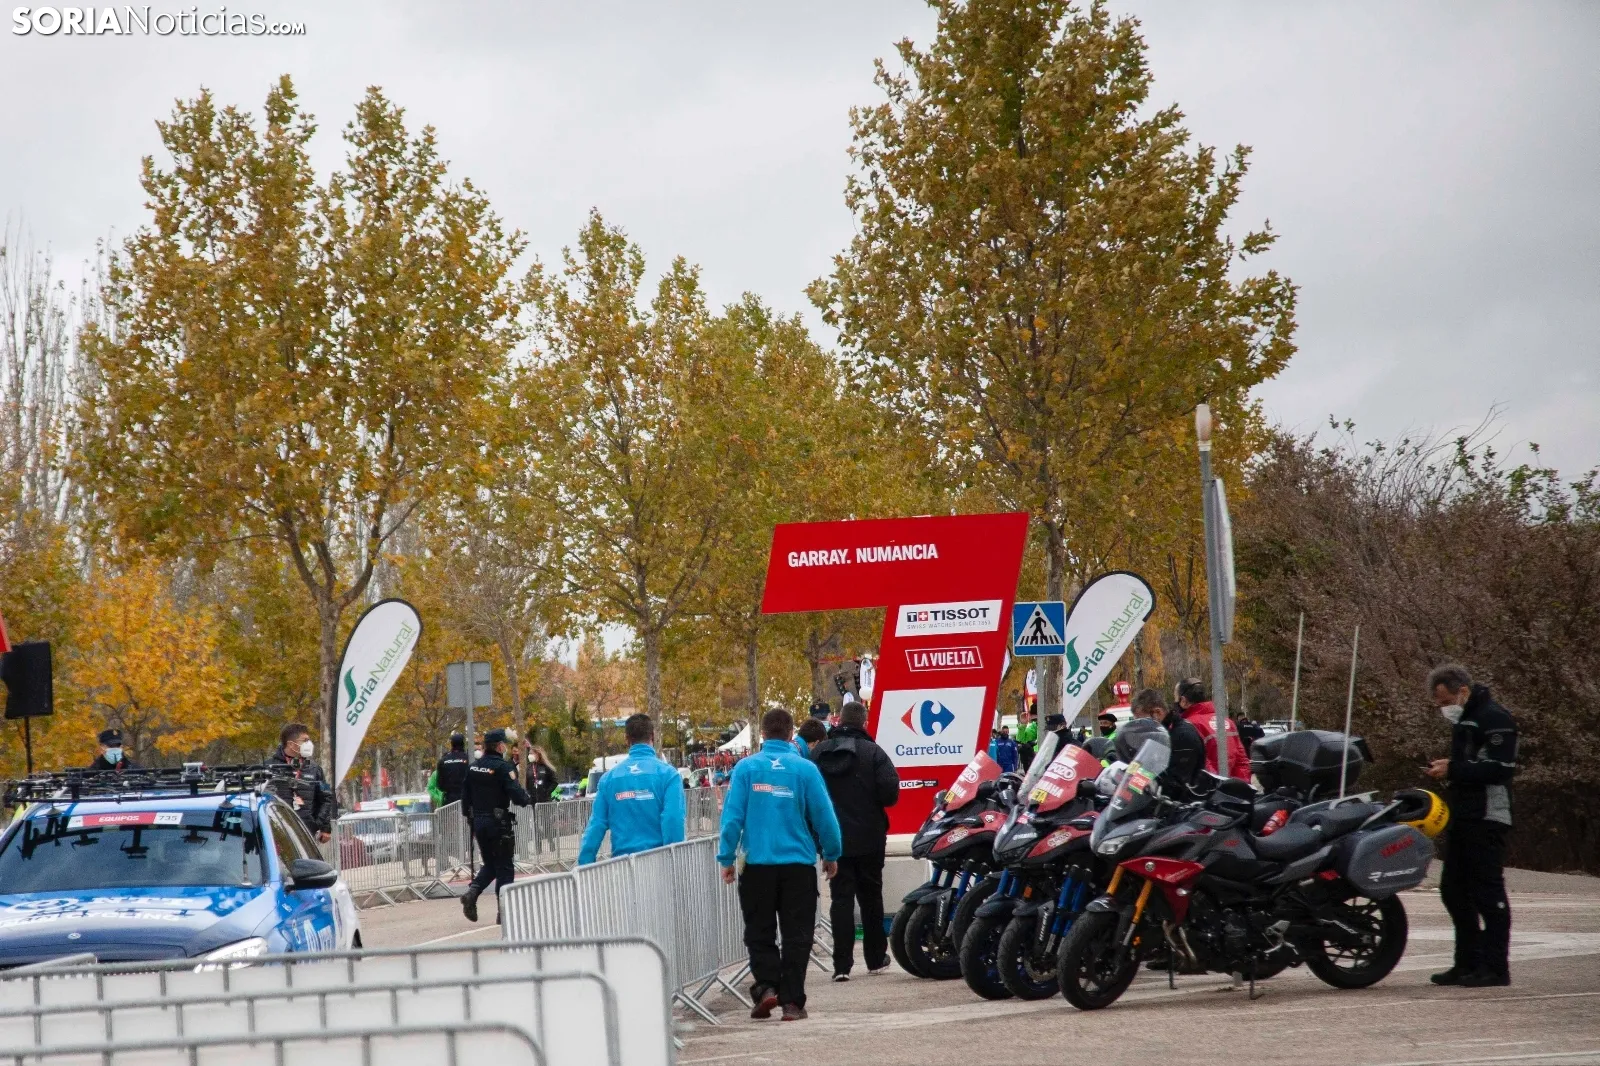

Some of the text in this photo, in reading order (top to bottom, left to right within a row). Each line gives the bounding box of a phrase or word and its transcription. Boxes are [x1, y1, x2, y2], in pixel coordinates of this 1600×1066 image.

[788, 543, 939, 568] GARRAY. NUMANCIA
[930, 607, 990, 621] TISSOT
[914, 650, 975, 668] LA VUELTA
[895, 742, 964, 757] Carrefour
[98, 815, 140, 823] EQUIPOS
